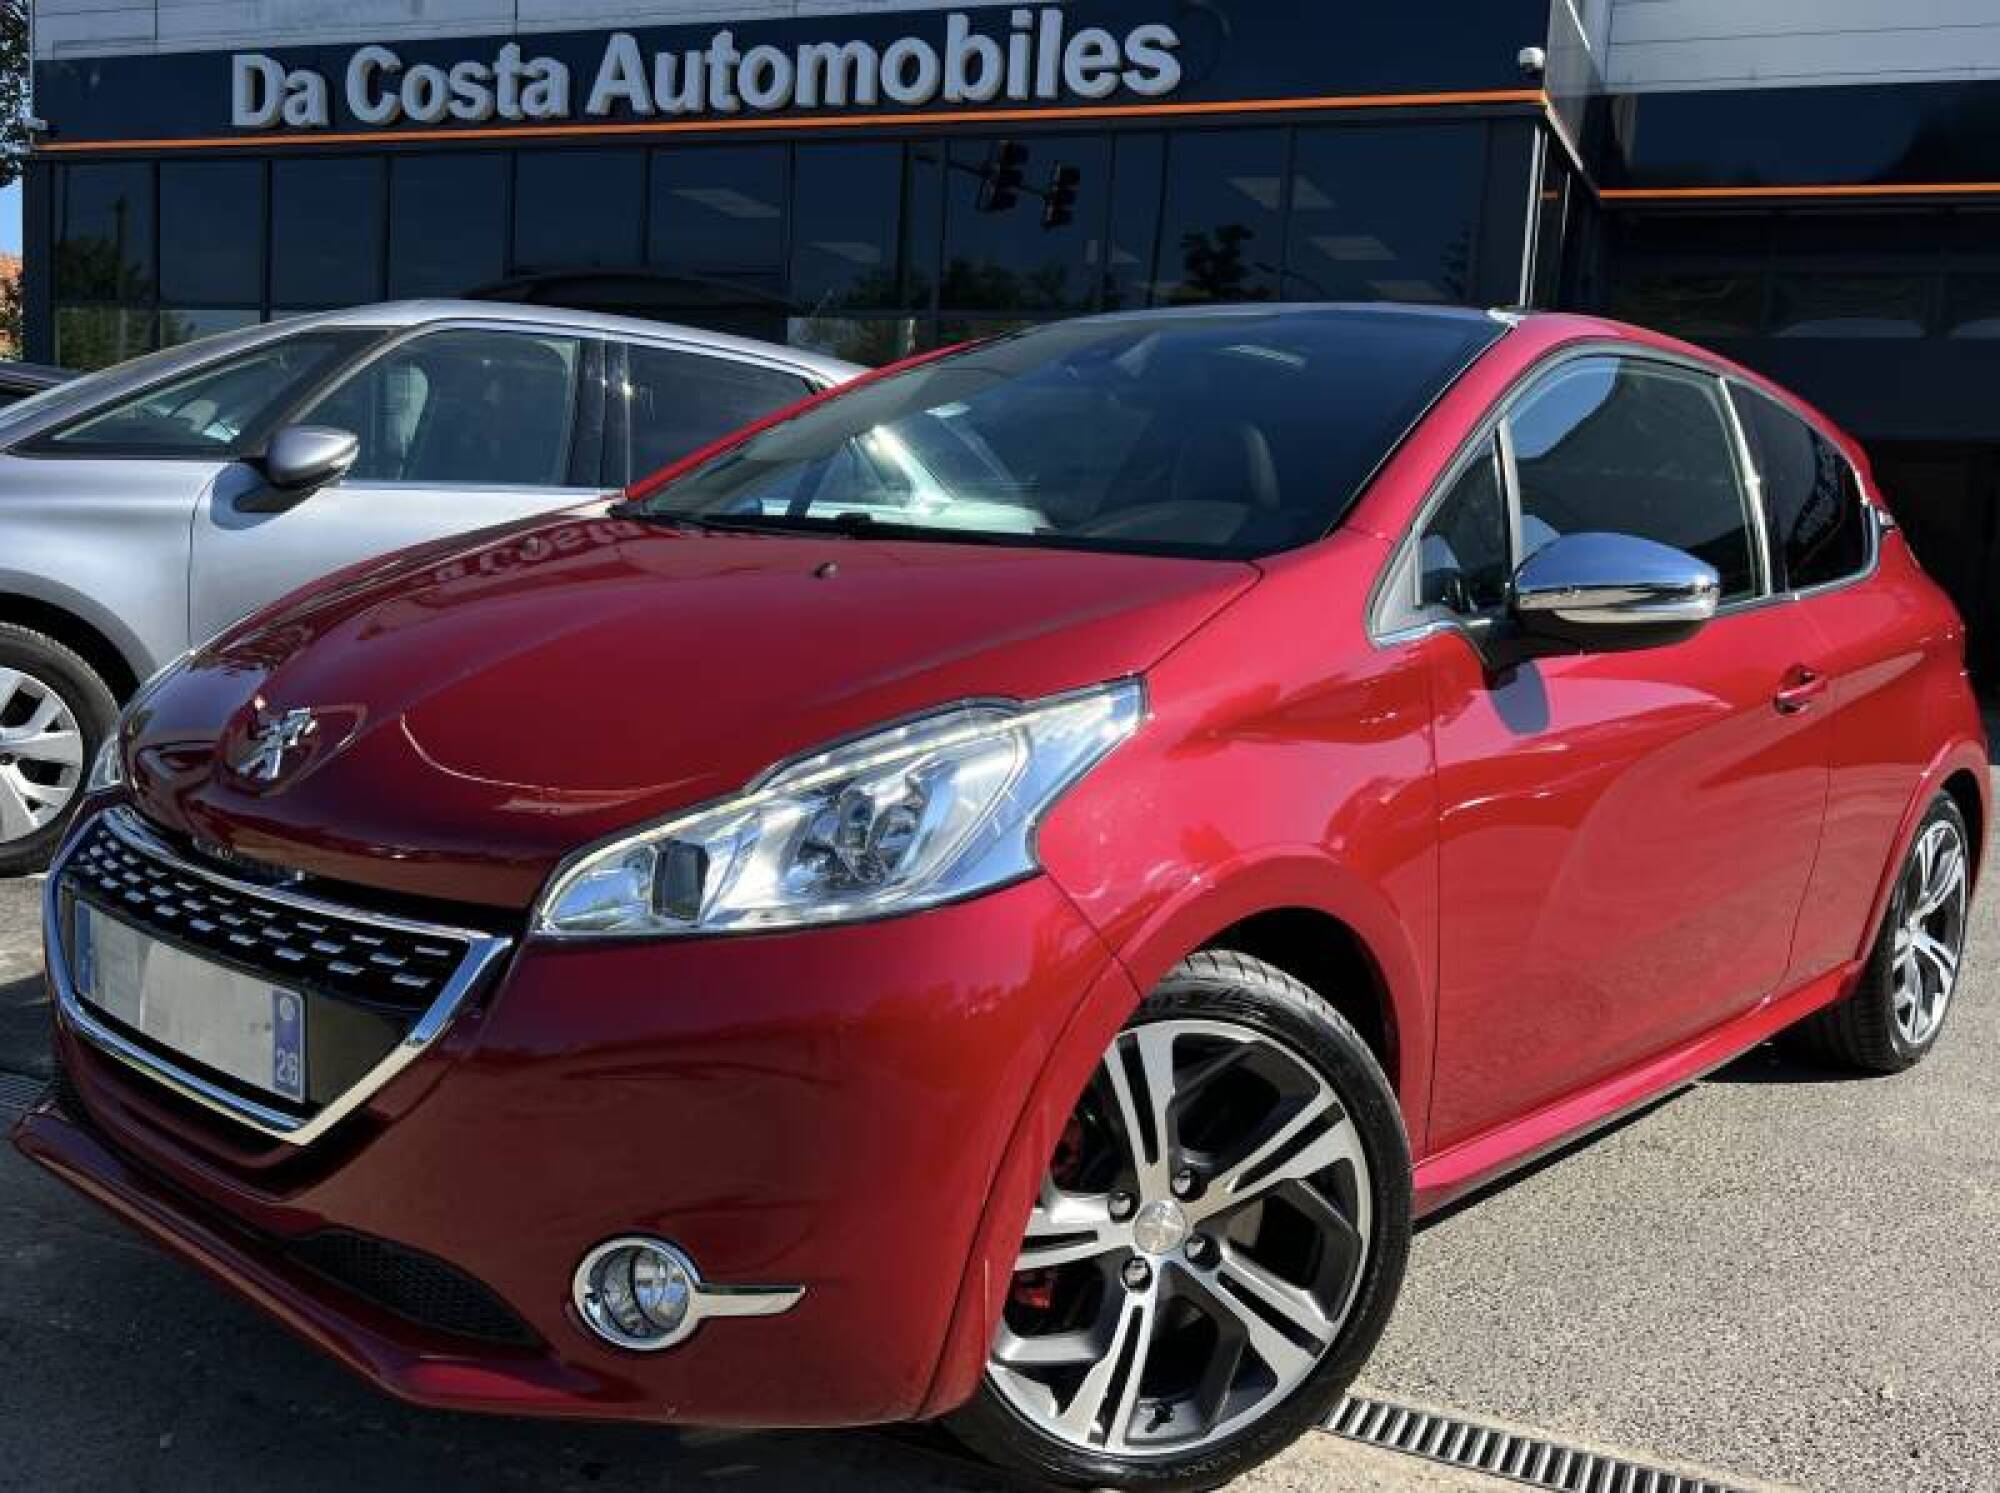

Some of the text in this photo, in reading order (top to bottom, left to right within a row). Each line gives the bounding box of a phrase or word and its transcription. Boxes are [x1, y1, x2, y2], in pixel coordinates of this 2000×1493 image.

[232, 9, 1182, 127] Da Costa Automobiles
